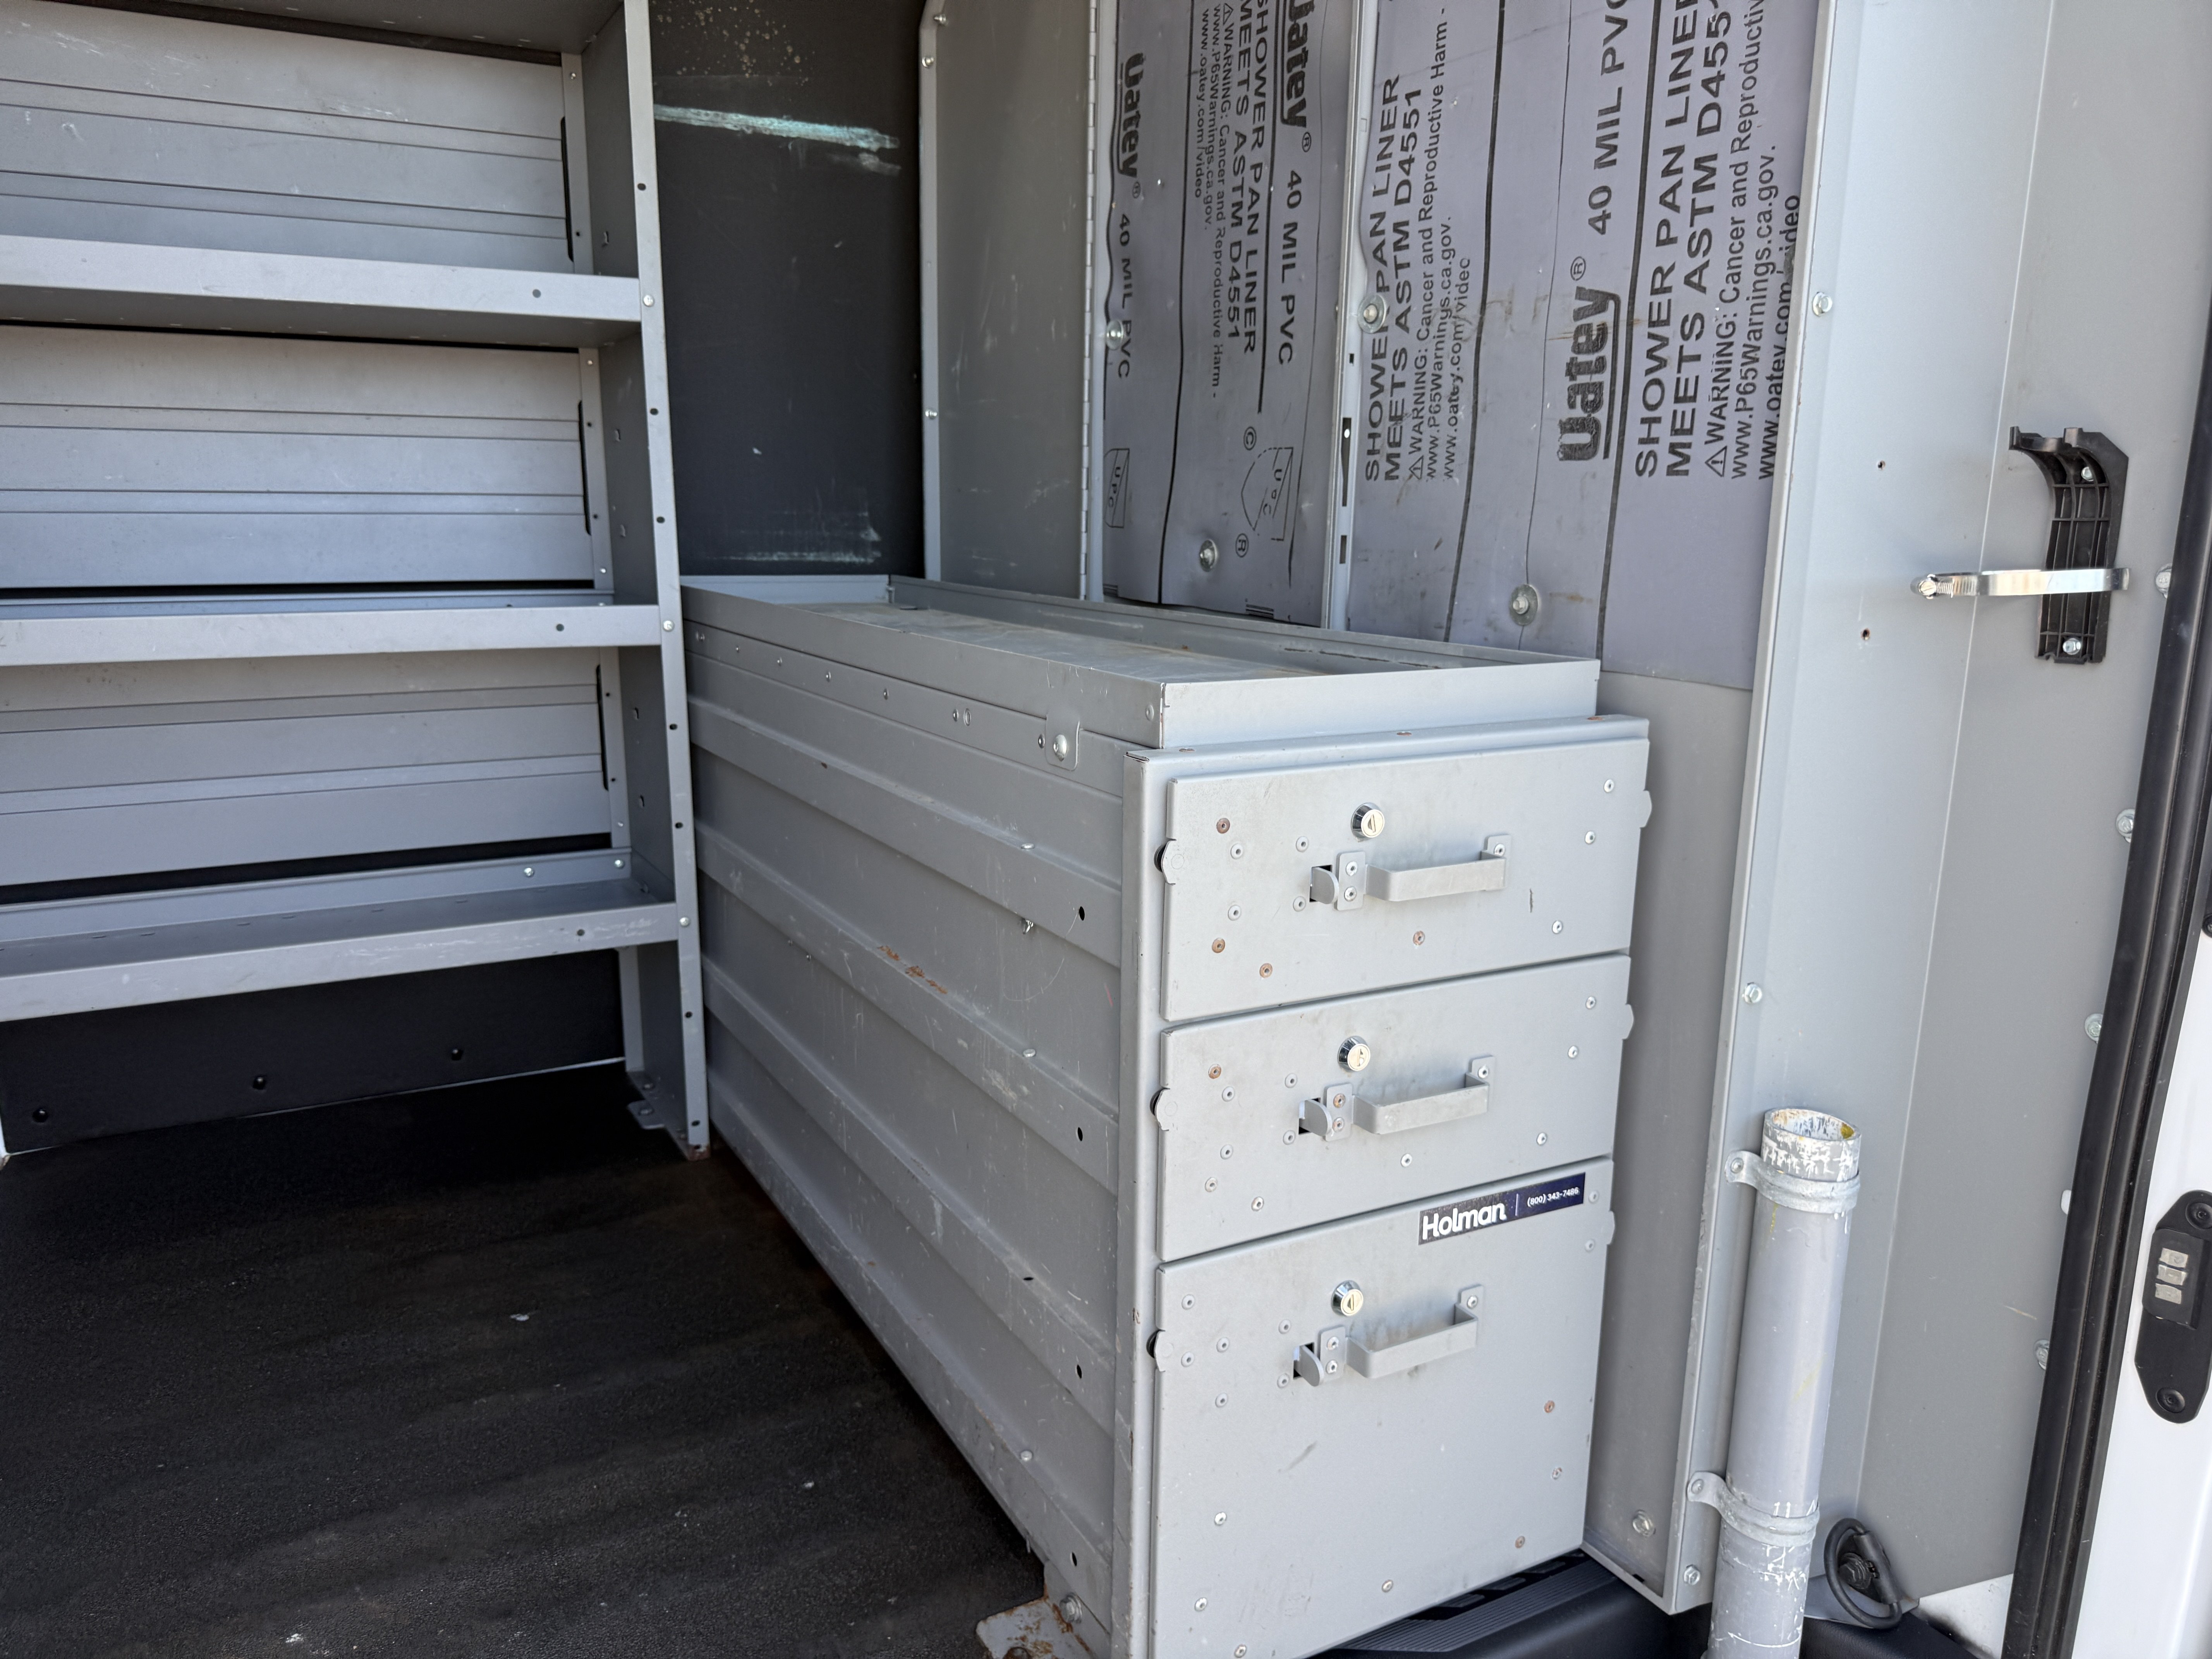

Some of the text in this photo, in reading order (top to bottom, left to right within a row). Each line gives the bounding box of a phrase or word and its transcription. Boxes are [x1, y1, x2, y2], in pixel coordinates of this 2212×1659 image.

[1220, 22, 1234, 119] WARNING:
[1431, 22, 1447, 79] Harm
[1195, 9, 1209, 198] www.oatey.com/video
[1203, 3, 1221, 230] www.P65Warnings.ca.gov.
[1594, 87, 1622, 169] MIL
[1218, 125, 1230, 186] Cancer
[1231, 131, 1247, 228] ASTM
[1286, 170, 1302, 209] 40
[1418, 84, 1444, 221] Reproductive
[1729, 161, 1748, 207] and
[1119, 214, 1130, 246] 40
[1216, 189, 1226, 221] and
[1247, 162, 1263, 236] PAN
[1588, 186, 1612, 235] 40
[1684, 154, 1718, 294] ASTM
[1121, 258, 1133, 309] MIL
[1212, 228, 1226, 337] Reproductive
[1281, 222, 1298, 283] MIL
[1365, 75, 1399, 481] SHOWE PAN LINER
[1385, 89, 1421, 481] MEETS ASTM D4551
[1418, 228, 1434, 264] and
[1720, 217, 1745, 304] Cancer
[1228, 240, 1242, 338] D4551
[1244, 249, 1258, 354] LINER
[1278, 295, 1295, 365] PVC
[1417, 273, 1434, 341] Cancer
[1635, 261, 1675, 477] SHOWER
[1656, 144, 1685, 247] PAN
[1732, 146, 1779, 479] www.P65Warnings.ca.gov.
[1118, 320, 1132, 378] PVC
[1212, 344, 1223, 386] Harm
[1704, 312, 1737, 445] WARNING:
[1409, 348, 1428, 455] WARNING:
[1666, 312, 1704, 476] MEETS
[1422, 1187, 1580, 1240] Holman (800) 343-7486
